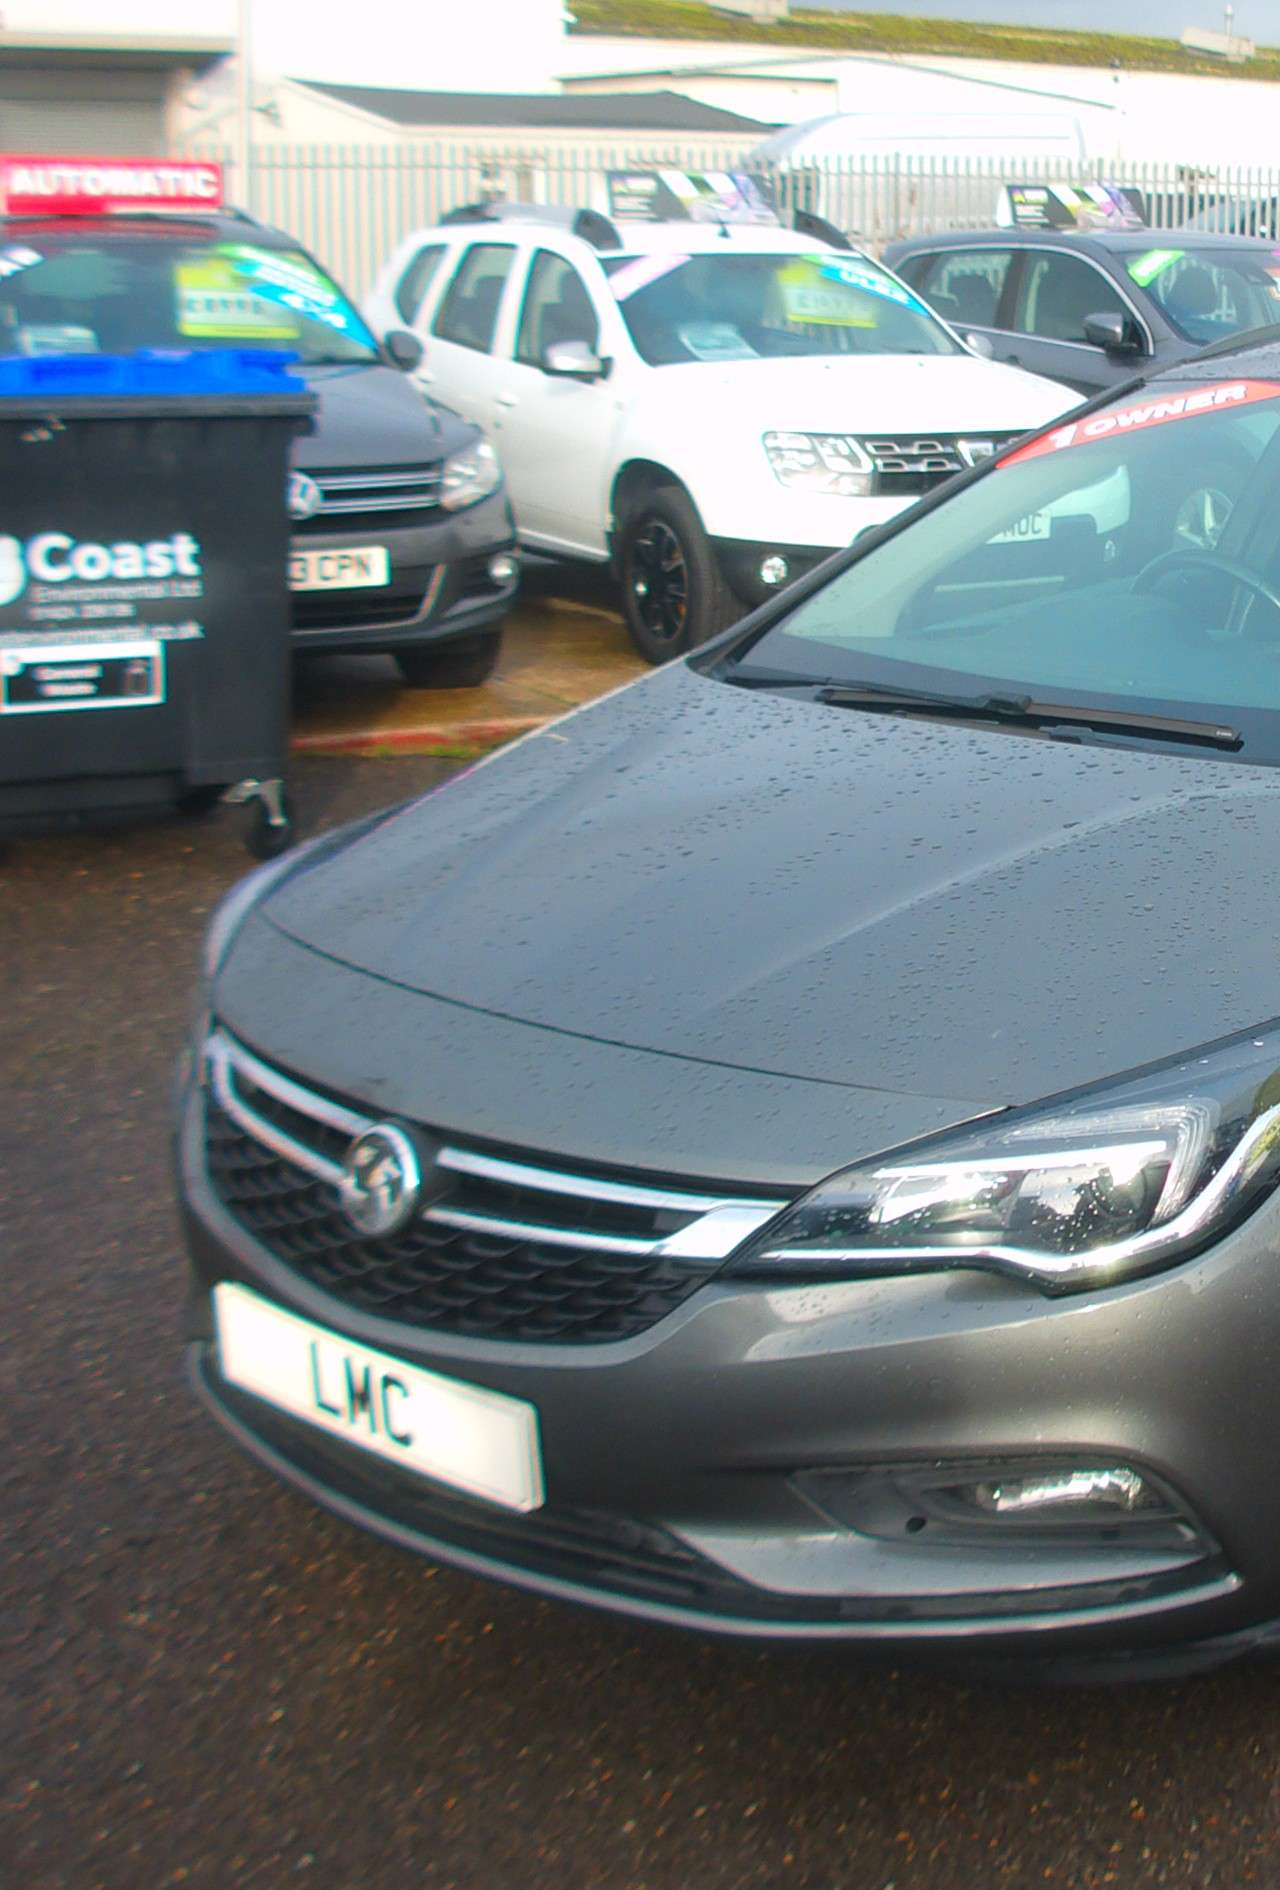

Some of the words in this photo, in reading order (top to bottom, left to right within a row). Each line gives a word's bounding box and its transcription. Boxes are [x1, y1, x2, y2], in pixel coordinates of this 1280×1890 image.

[9, 165, 218, 197] AUTOMATIC
[1049, 424, 1078, 449] 1
[1083, 385, 1248, 436] OWNER
[27, 531, 202, 582] Coast
[309, 1342, 413, 1446] LMC
